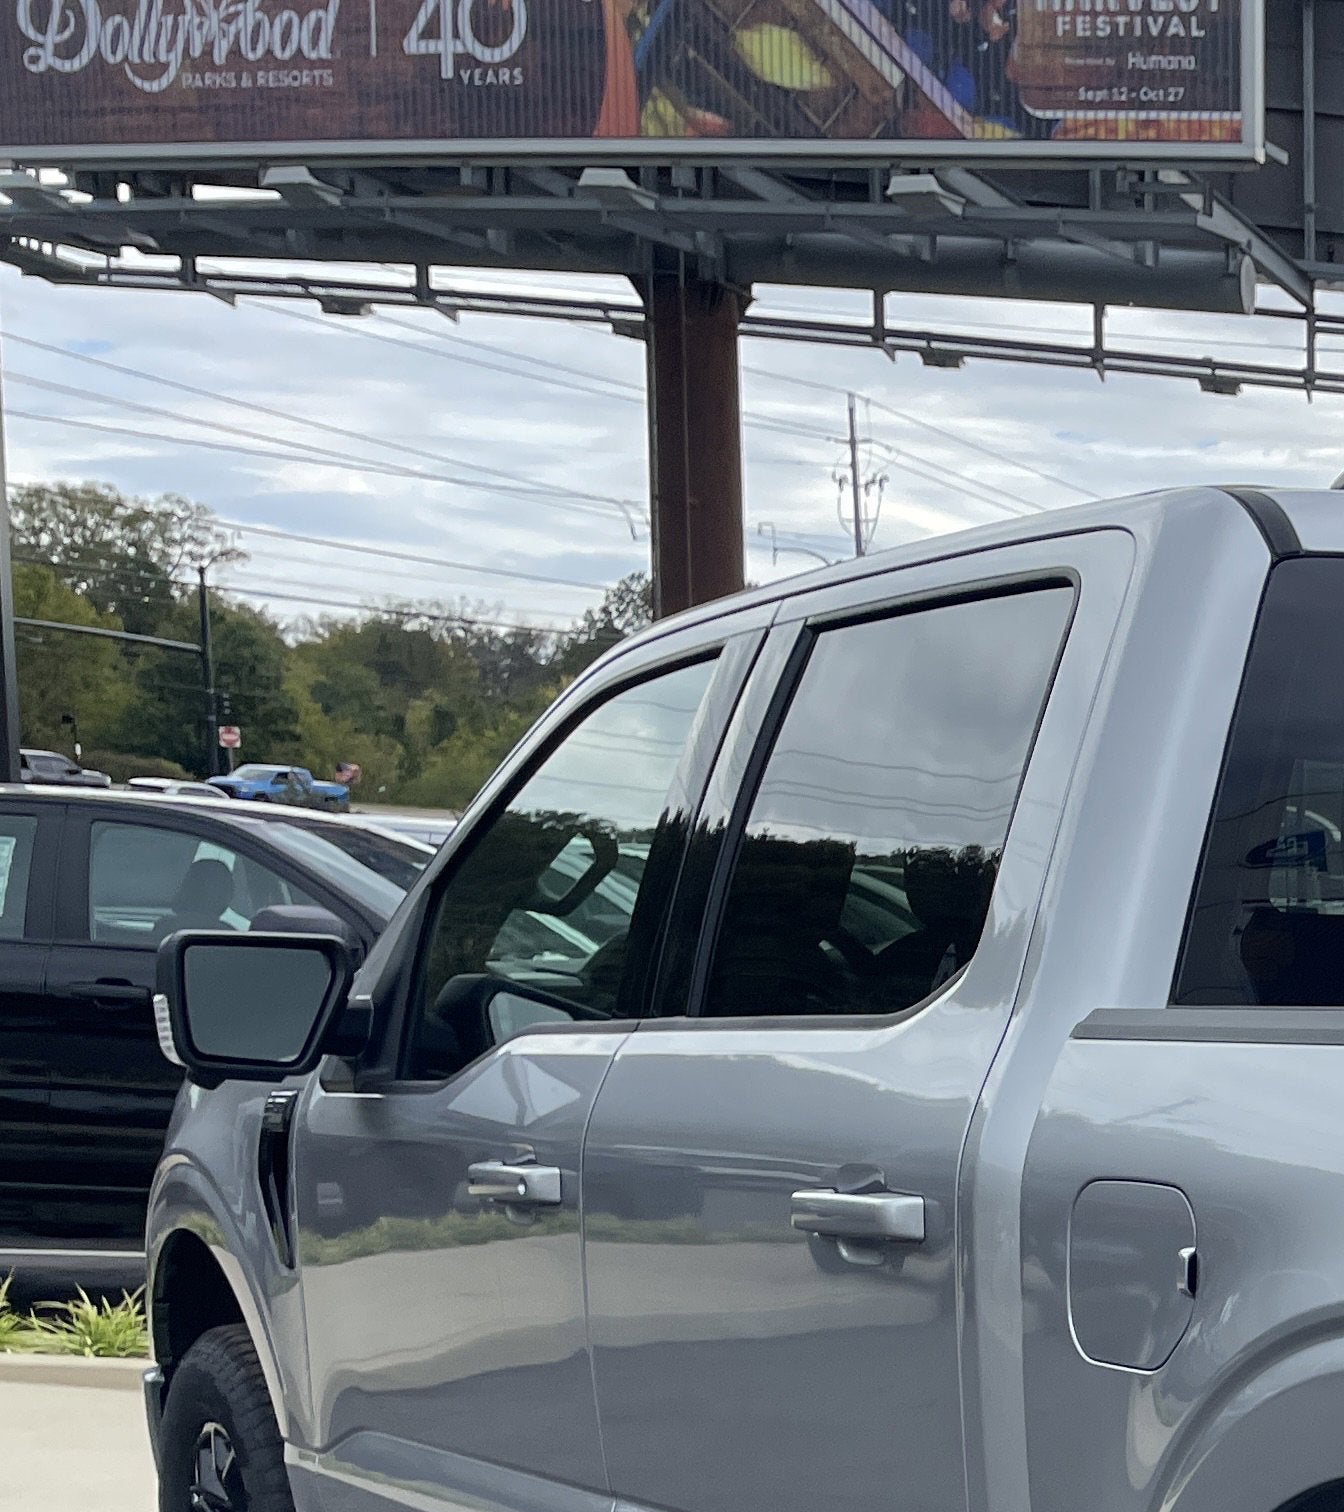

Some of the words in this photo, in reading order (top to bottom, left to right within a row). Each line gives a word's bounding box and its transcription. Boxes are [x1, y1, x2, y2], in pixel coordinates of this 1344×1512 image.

[1056, 15, 1206, 38] FESTIVAL
[17, 0, 340, 93] Dollywood
[402, 0, 528, 79] 40
[1127, 51, 1197, 70] Humana
[181, 71, 236, 90] PARKS
[239, 72, 252, 90] &
[256, 69, 334, 90] RESORTS
[458, 66, 525, 86] YEARS
[1078, 86, 1110, 102] Sept
[1112, 86, 1128, 101] 12
[1139, 86, 1164, 101] Oct
[1167, 86, 1185, 101] 27
